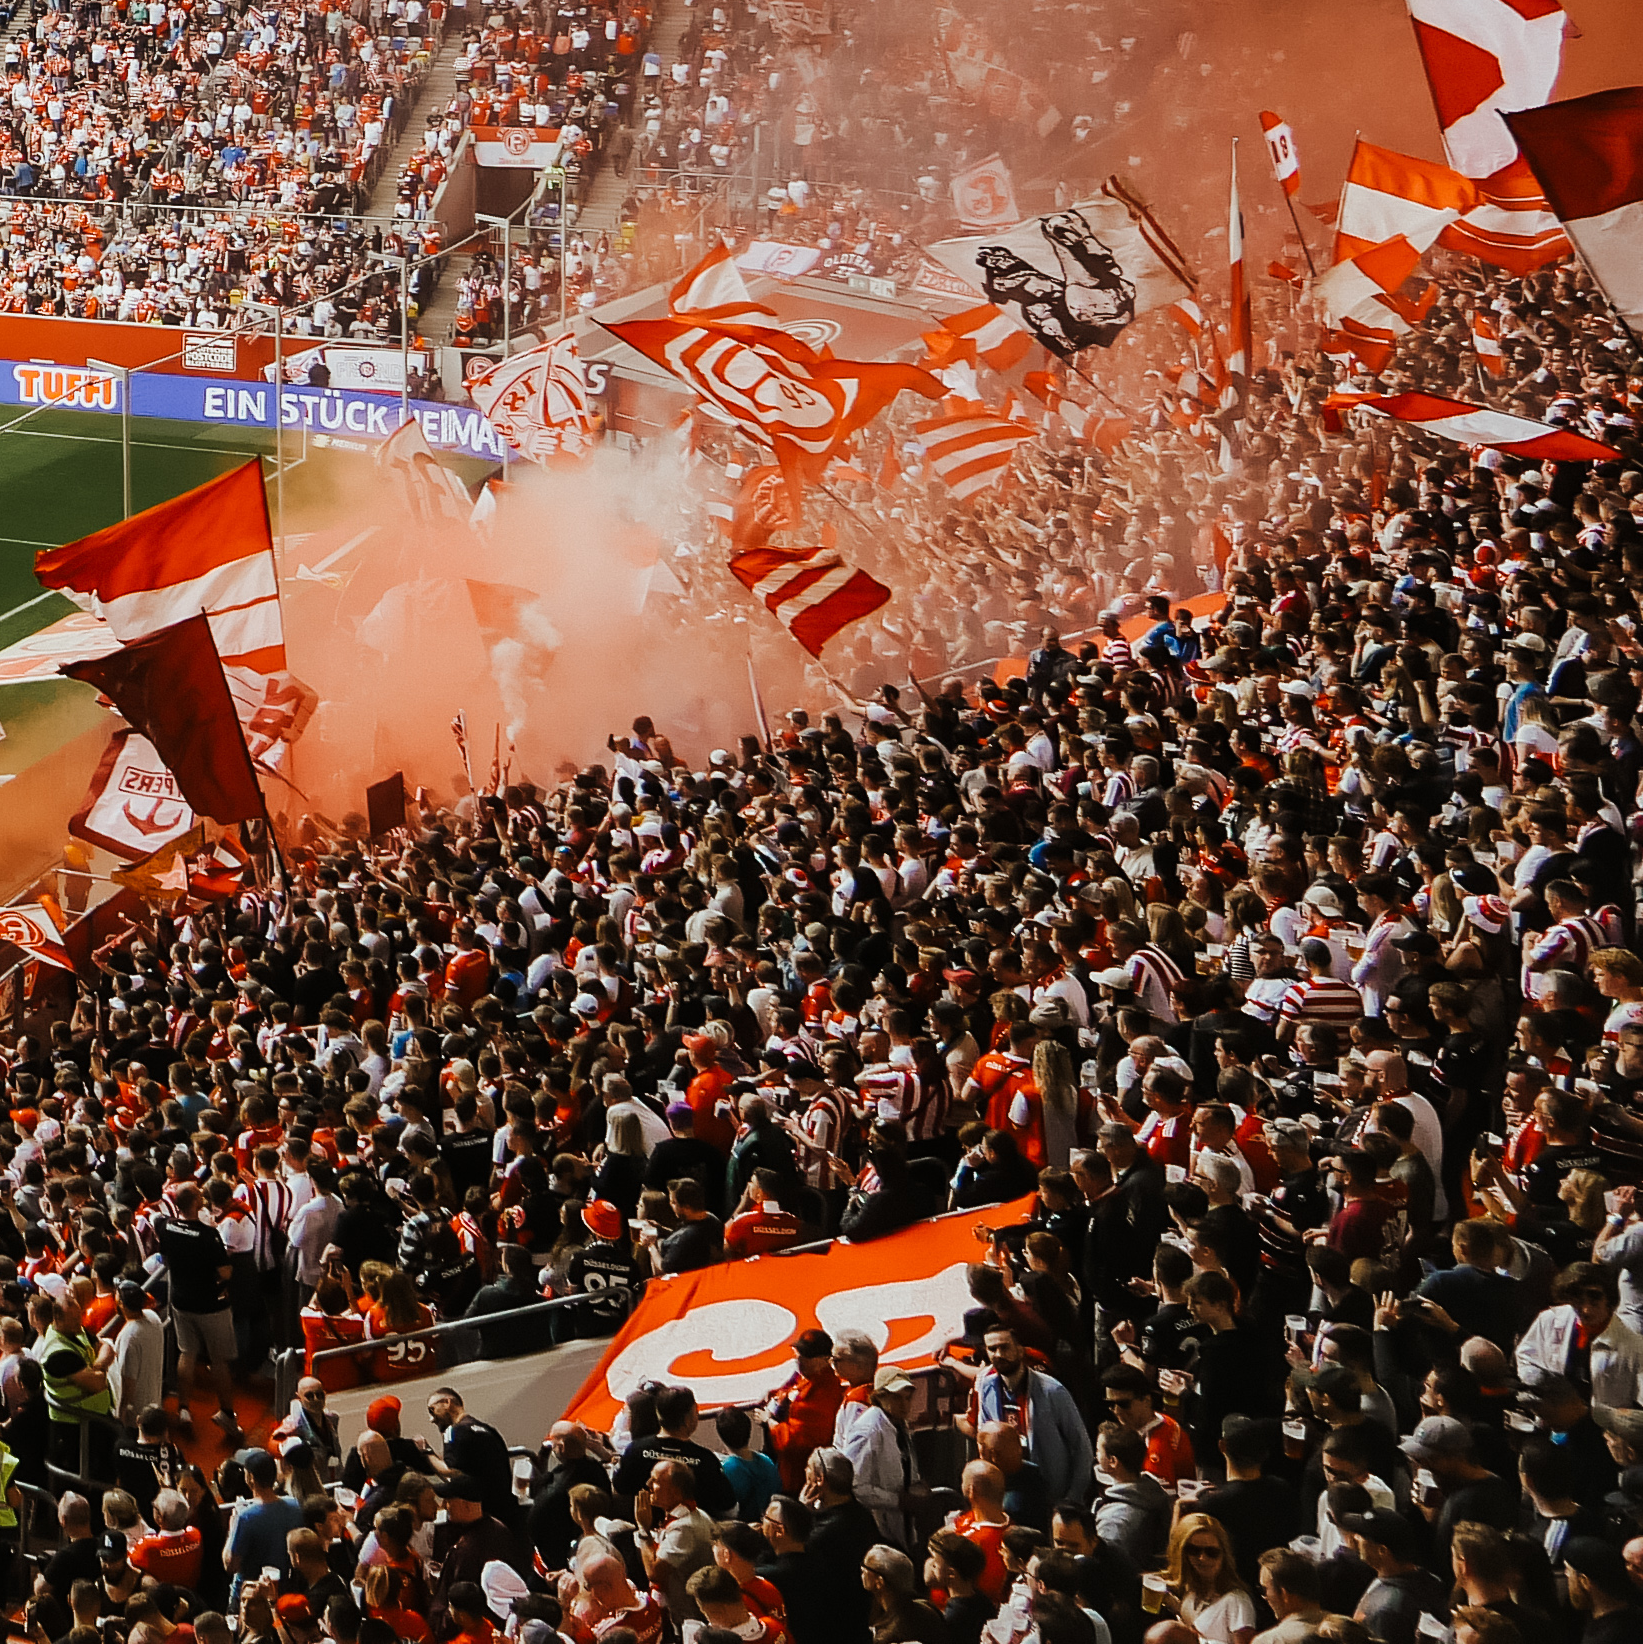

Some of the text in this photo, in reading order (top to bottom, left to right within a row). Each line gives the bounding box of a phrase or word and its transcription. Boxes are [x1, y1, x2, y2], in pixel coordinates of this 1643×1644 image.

[13, 363, 119, 411] TUFFI
[204, 386, 267, 423] EIN
[280, 385, 390, 436] STÜCK
